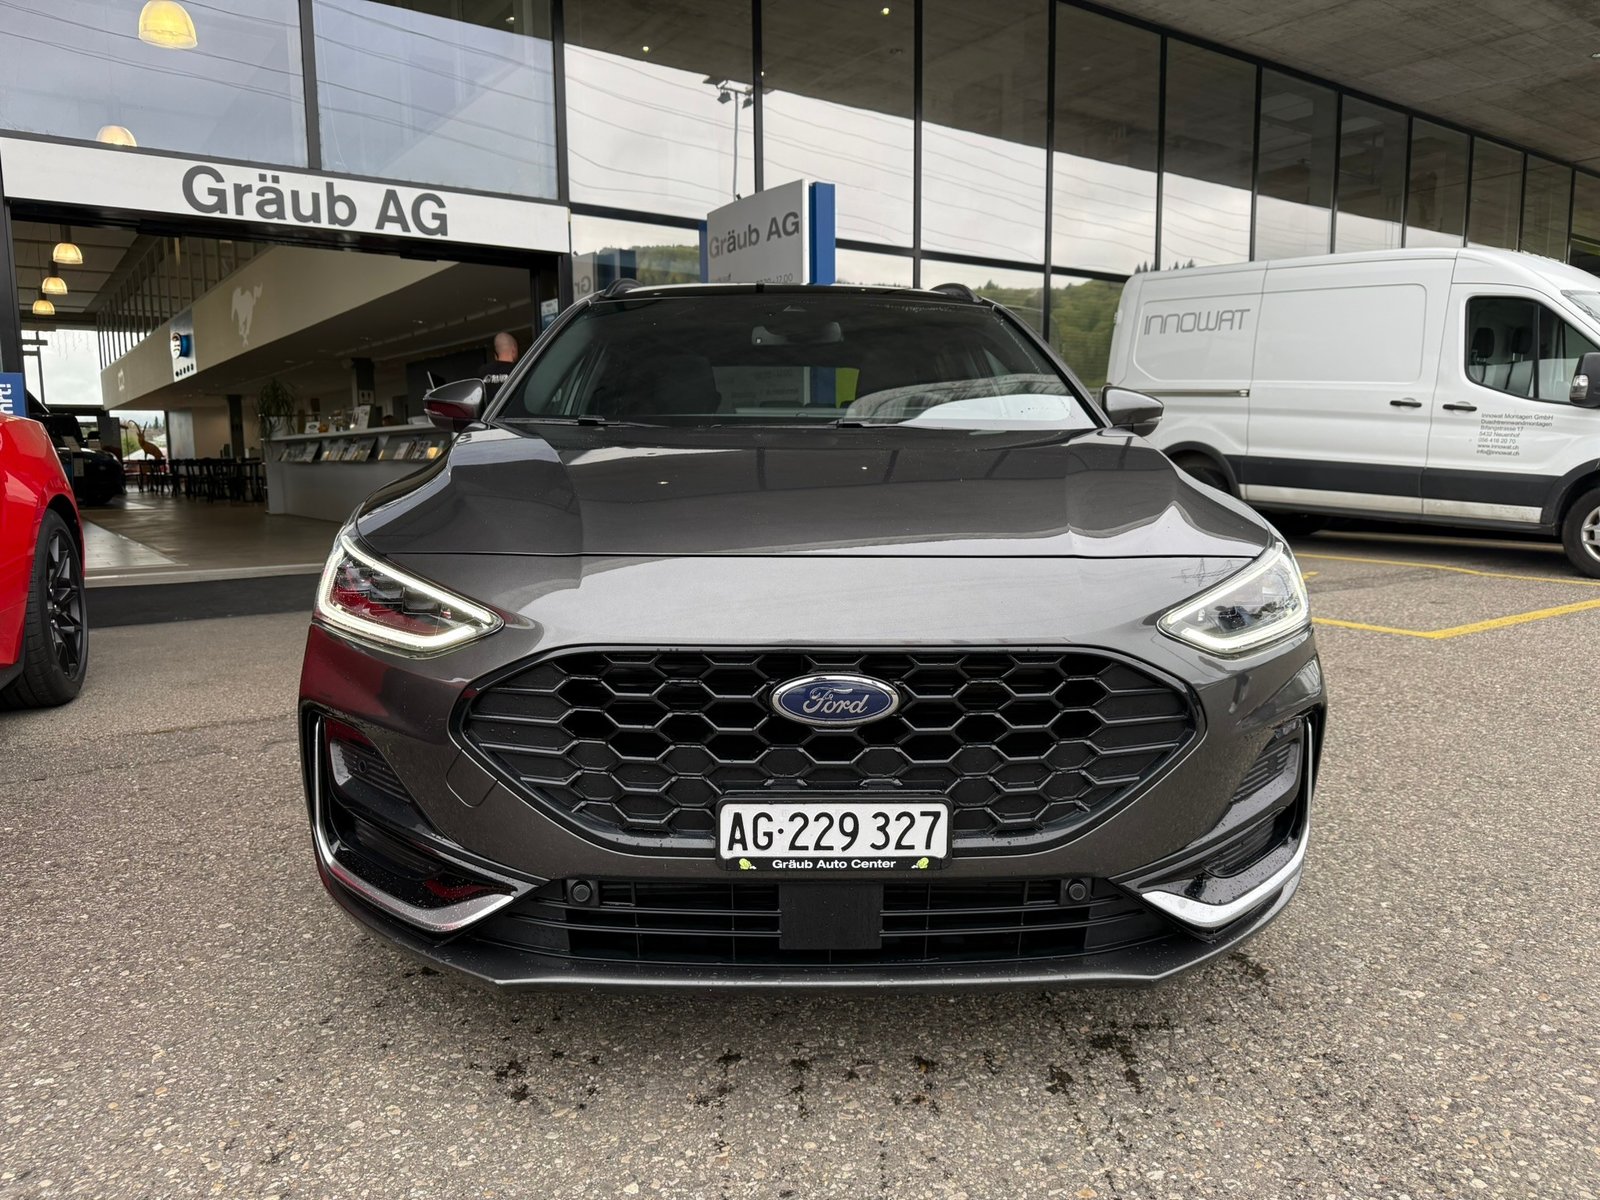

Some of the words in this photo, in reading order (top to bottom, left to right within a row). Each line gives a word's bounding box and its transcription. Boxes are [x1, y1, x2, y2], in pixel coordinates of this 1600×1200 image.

[182, 165, 357, 227] Gräub
[375, 188, 448, 237] AG
[709, 223, 760, 259] Gräub
[766, 211, 800, 242] AG
[802, 686, 870, 714] Ford
[870, 811, 941, 850] 327
[772, 860, 813, 869] Gräub
[816, 860, 848, 869] Auto
[851, 859, 896, 869] Center
